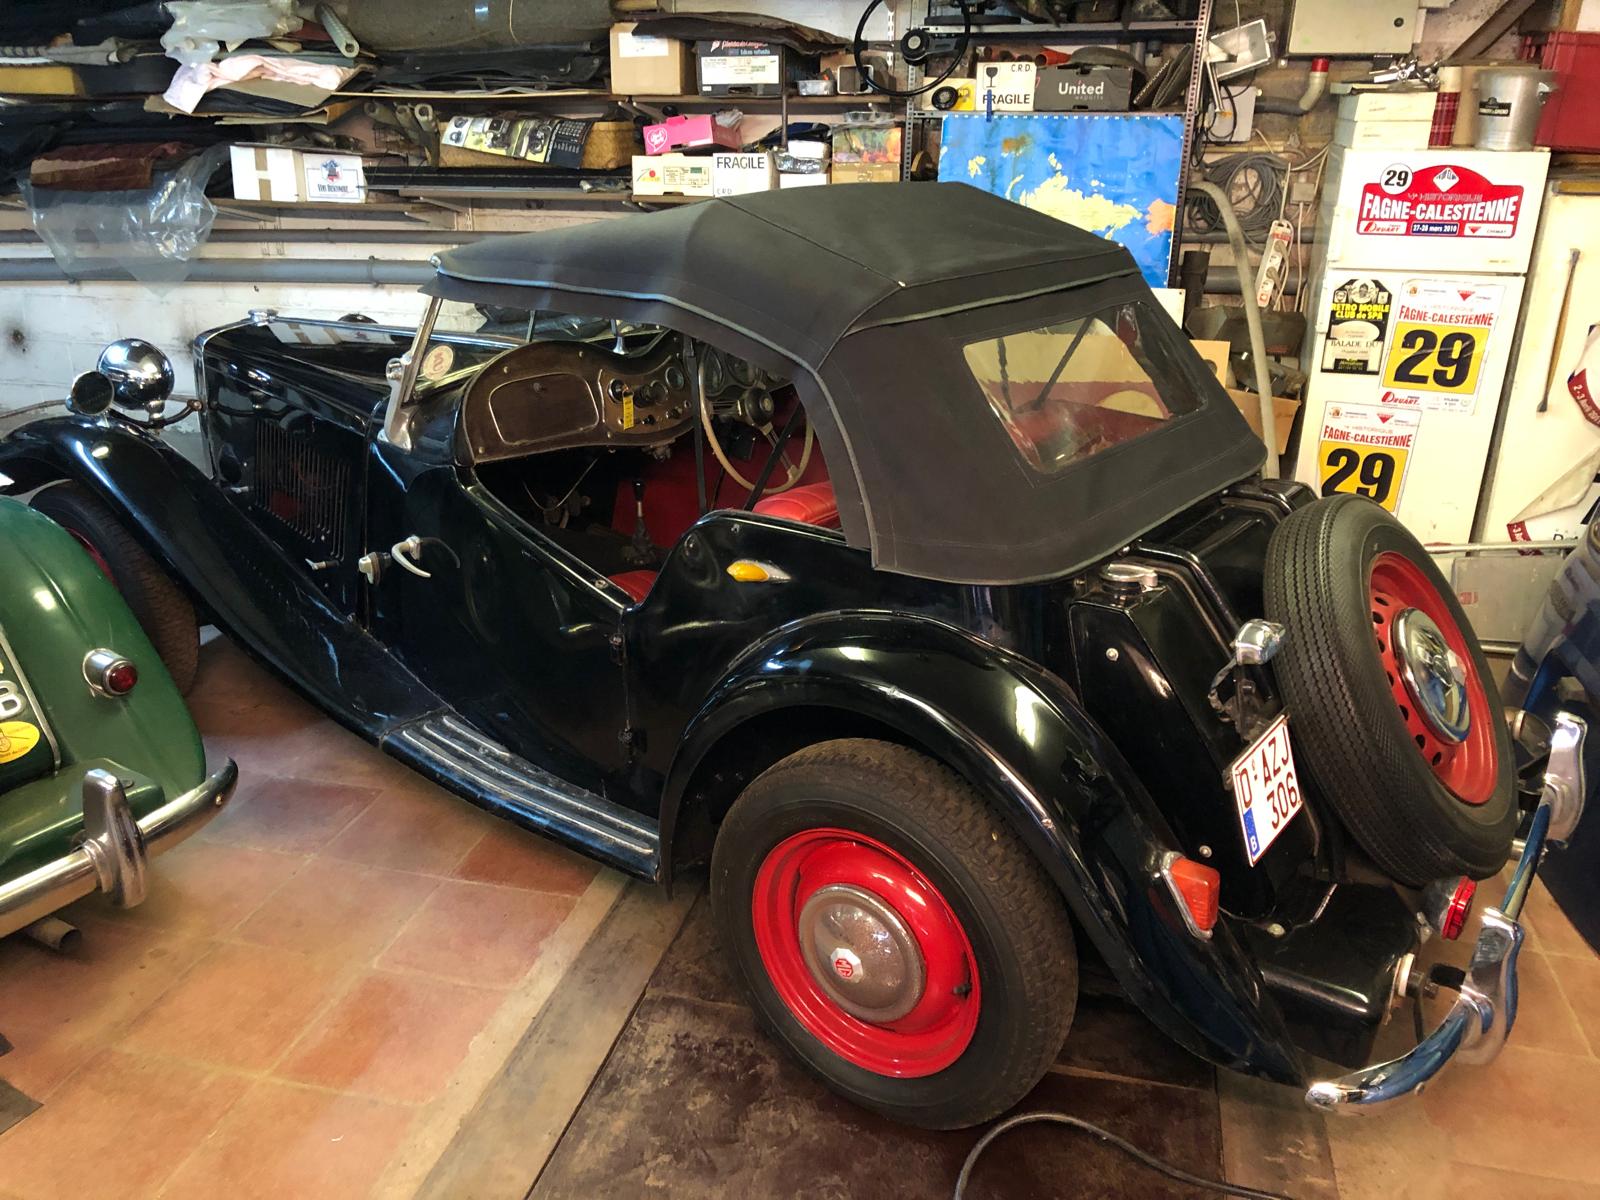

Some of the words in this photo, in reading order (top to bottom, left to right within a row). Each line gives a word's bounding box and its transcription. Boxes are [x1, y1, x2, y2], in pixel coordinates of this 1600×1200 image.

[1058, 81, 1104, 95] United
[982, 94, 1031, 104] FRAGILE
[716, 156, 765, 169] FRAGILE
[1384, 169, 1409, 187] 29
[1362, 192, 1519, 222] FAGNE-CALESTIENNE
[1330, 303, 1357, 311] RETRO
[1358, 304, 1389, 312] MOBILE
[1367, 312, 1383, 320] SPA
[1399, 305, 1494, 326] FAGNE-CALESTIENNE
[1393, 329, 1476, 388] 29
[1323, 425, 1413, 448] FAGNE-CALESTIENNE
[1321, 447, 1396, 504] 29
[1267, 771, 1298, 829] 306
[1250, 836, 1258, 852] B
[836, 959, 854, 978] MG
